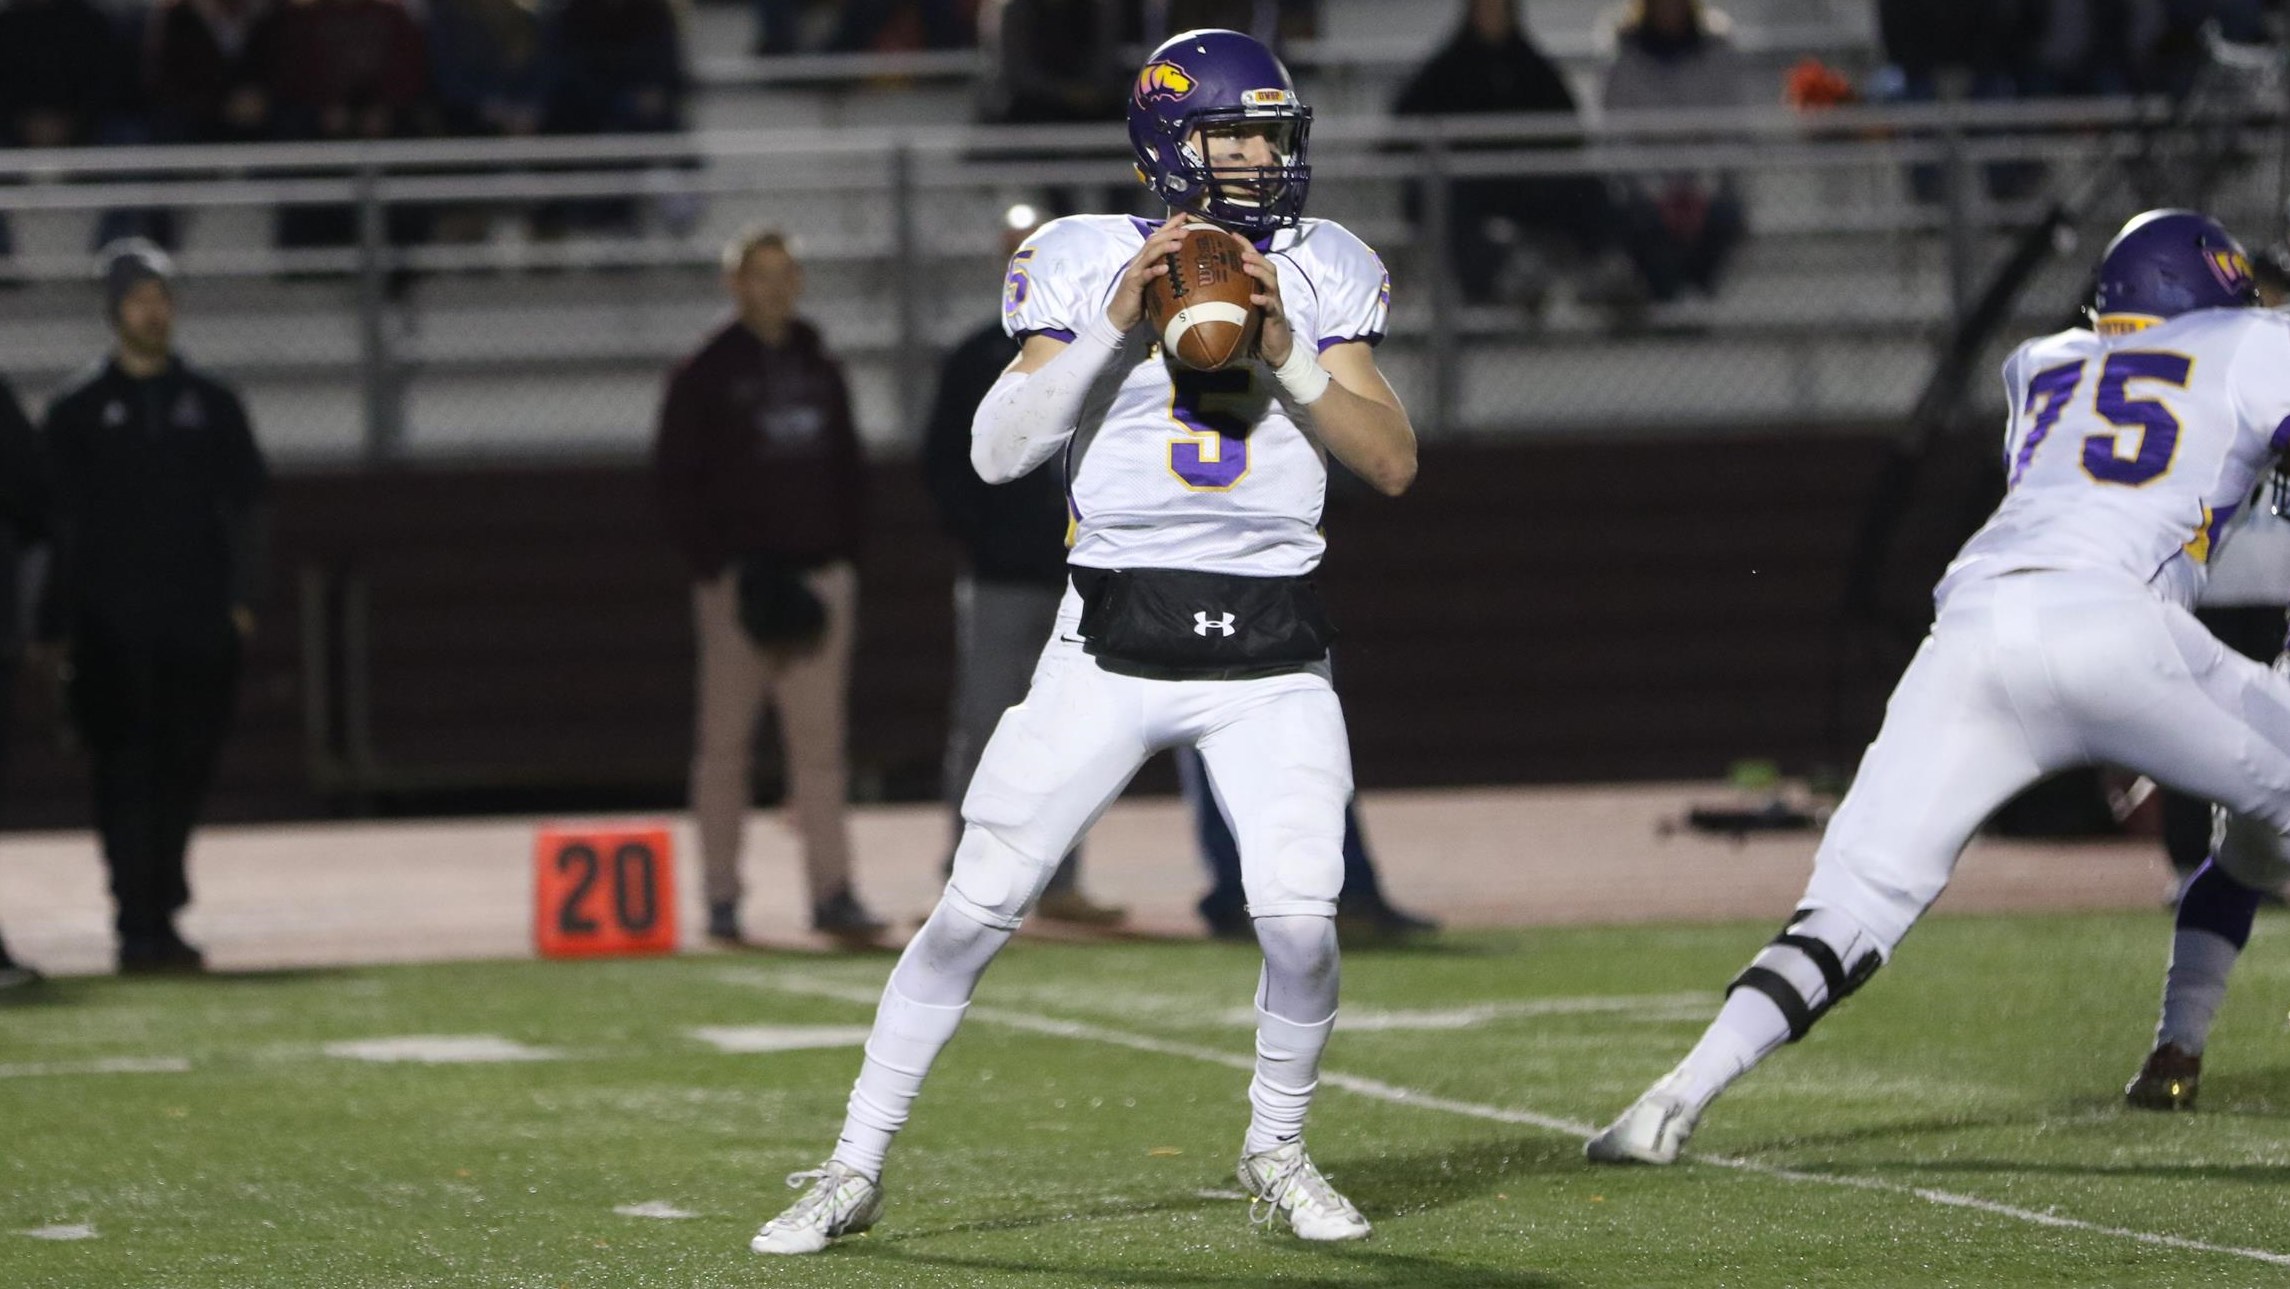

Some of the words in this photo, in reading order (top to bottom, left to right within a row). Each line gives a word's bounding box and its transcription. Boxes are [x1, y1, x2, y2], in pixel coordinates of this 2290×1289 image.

[1167, 365, 1254, 492] 5
[2009, 351, 2195, 490] 75
[557, 843, 657, 934] 20
